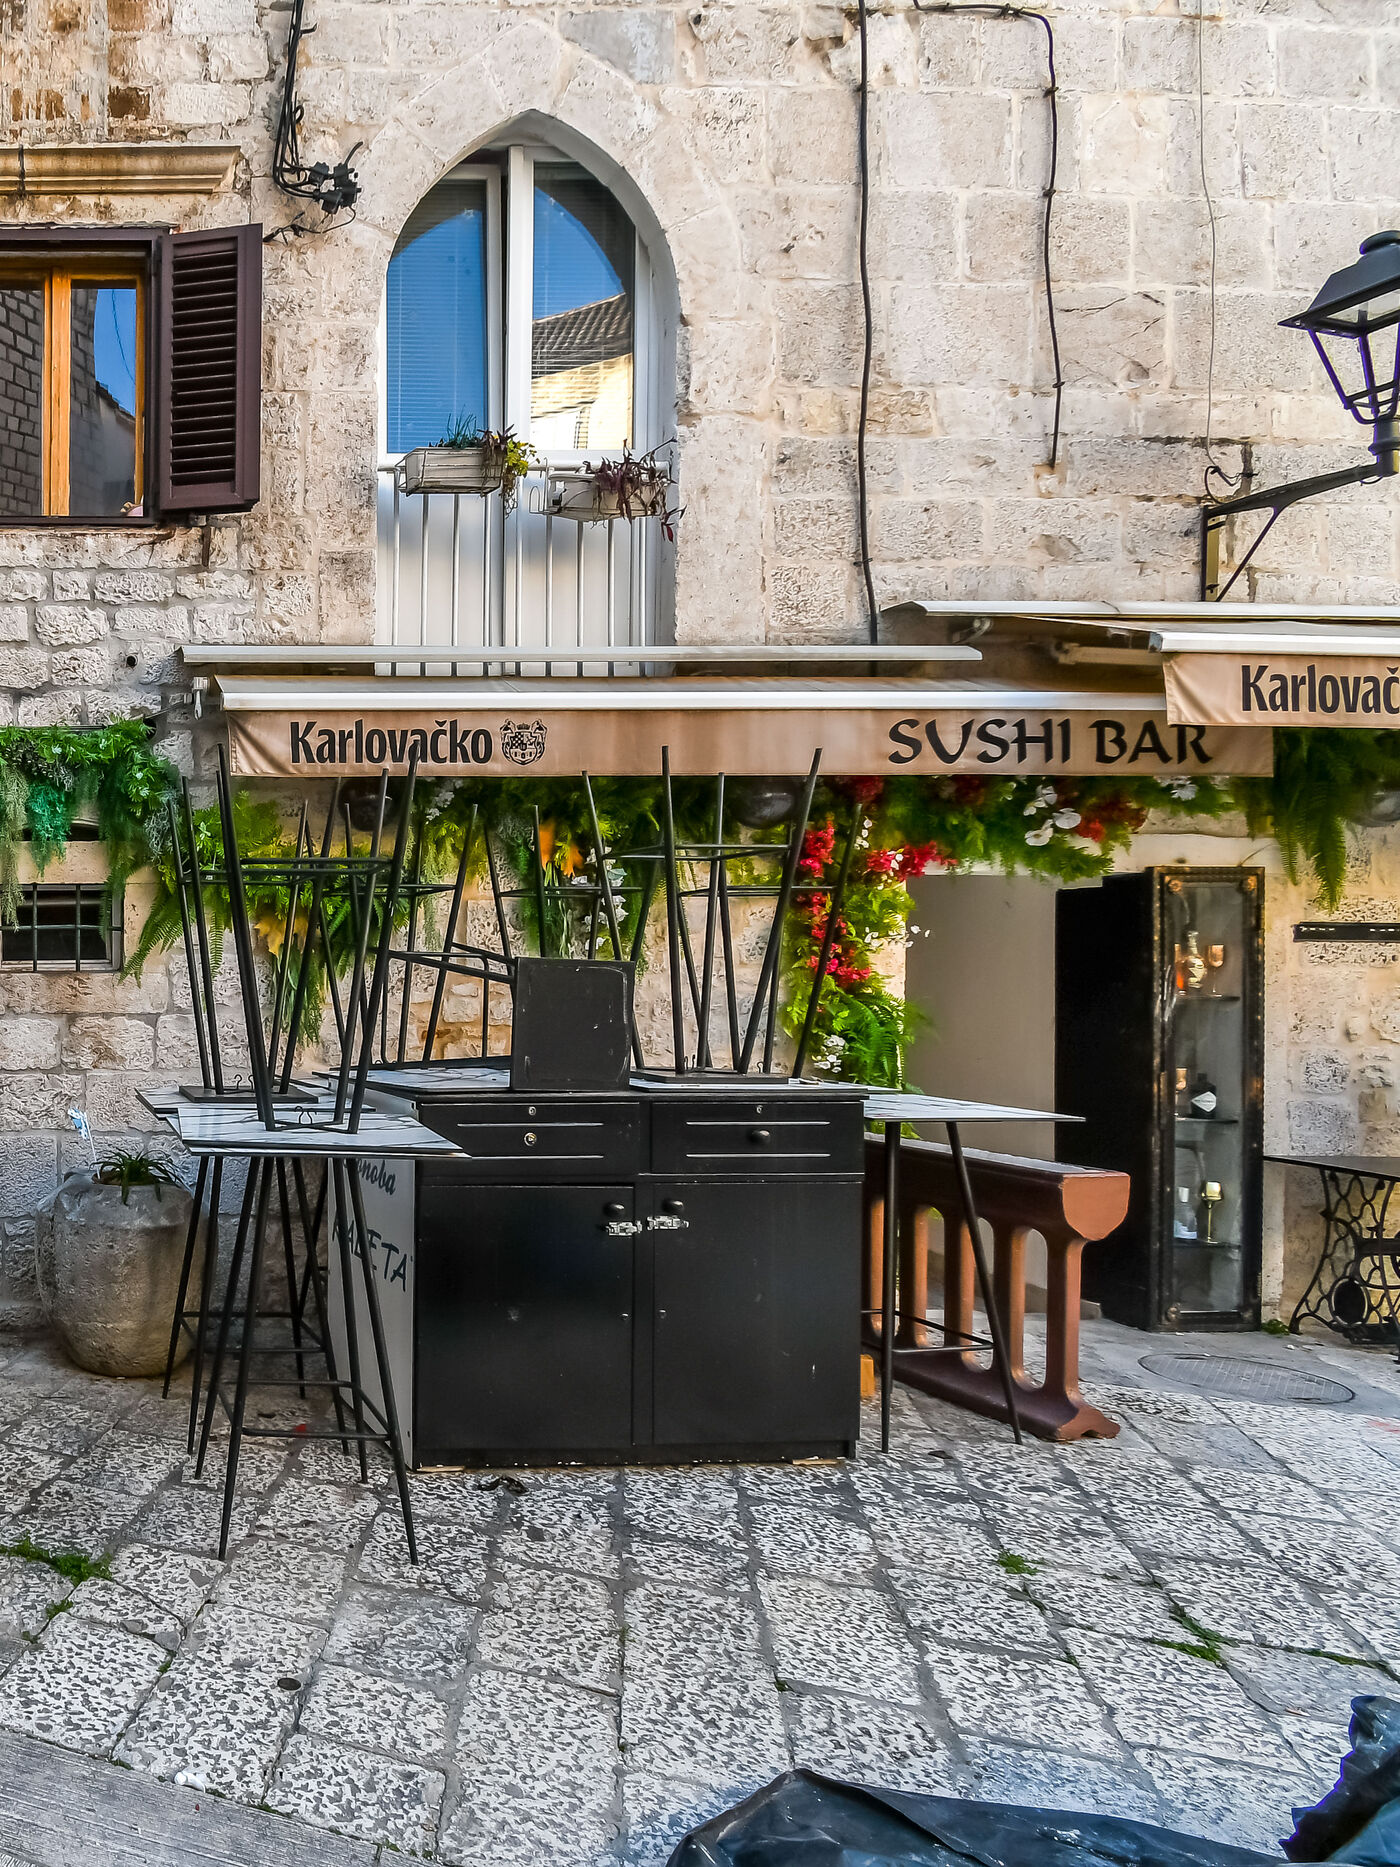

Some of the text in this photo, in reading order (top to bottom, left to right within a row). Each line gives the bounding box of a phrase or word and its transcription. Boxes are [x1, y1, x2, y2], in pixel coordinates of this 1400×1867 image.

[290, 719, 493, 764] Karlovačko
[887, 717, 1215, 766] SUSHI BAR
[343, 1158, 396, 1195] onoba
